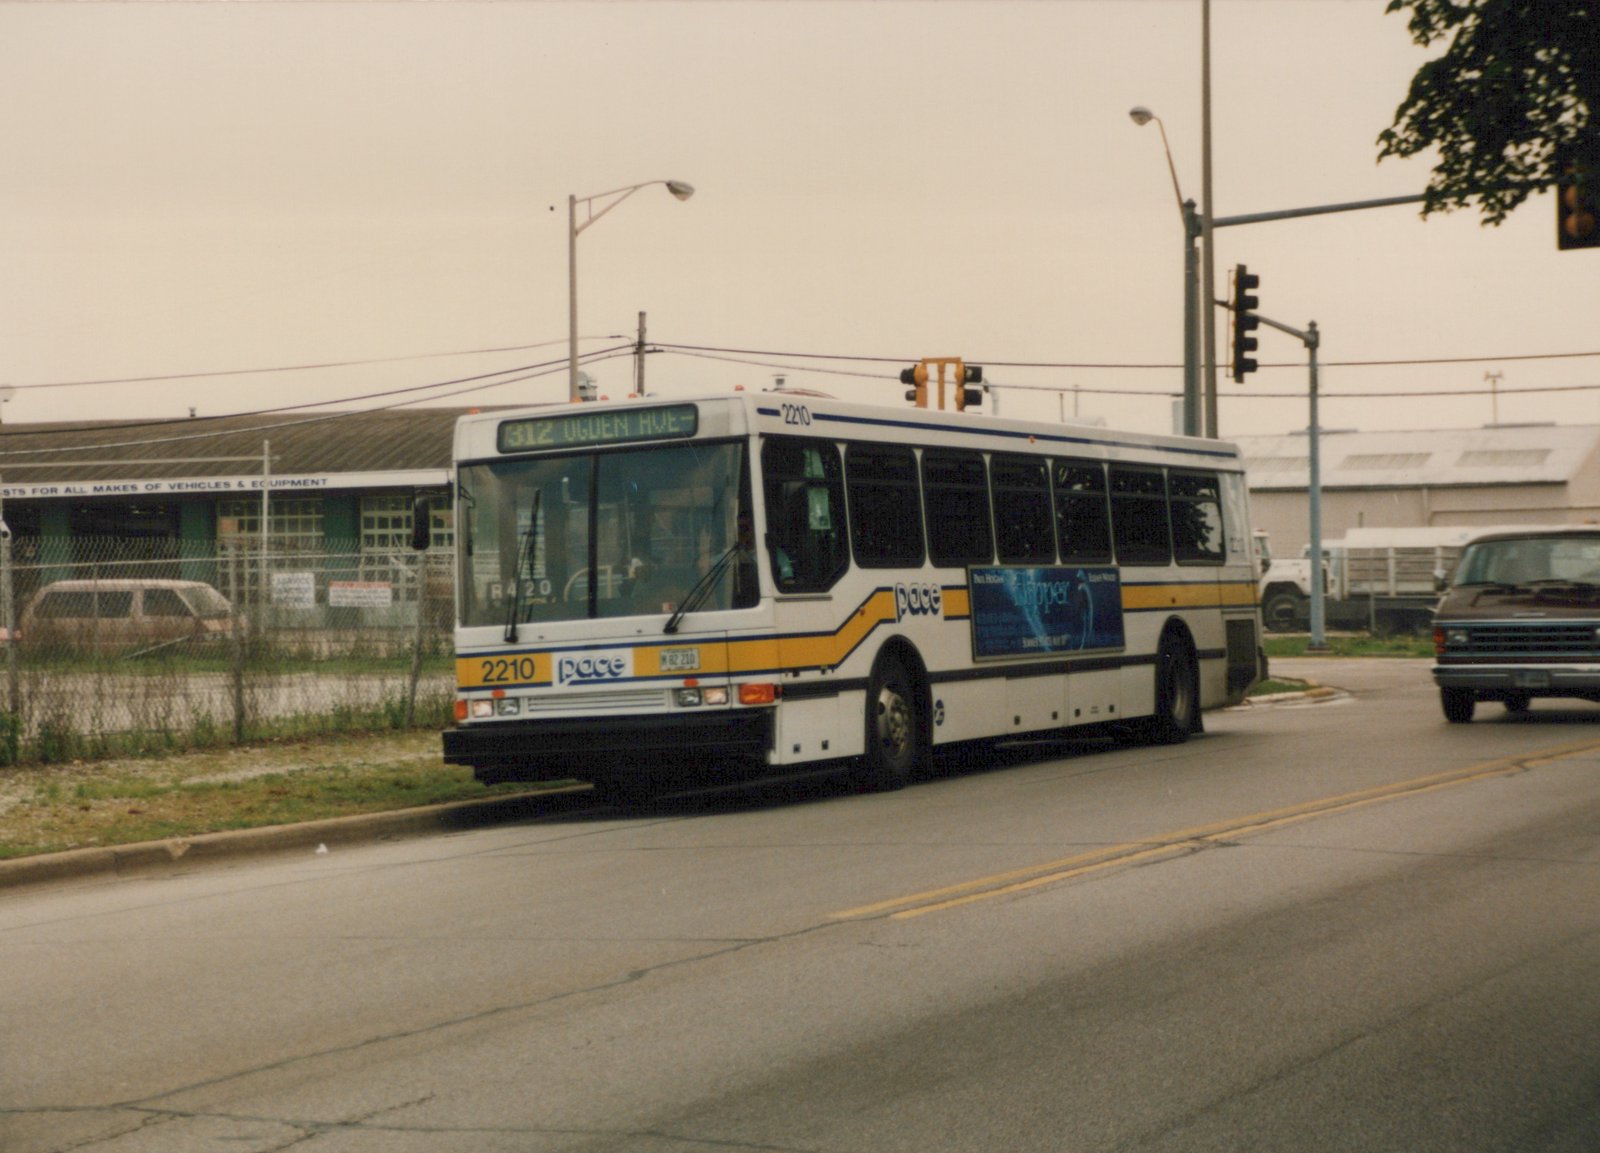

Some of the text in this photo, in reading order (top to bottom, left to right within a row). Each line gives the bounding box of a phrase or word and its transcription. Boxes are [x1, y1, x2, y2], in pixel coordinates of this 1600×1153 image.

[781, 403, 811, 427] 2210
[508, 420, 555, 446] 312
[564, 414, 630, 441] OGDEN
[0, 487, 26, 496] STS
[32, 487, 58, 495] FOR
[64, 486, 88, 494] ALL
[93, 484, 138, 493] MAKES
[144, 483, 162, 491] OF
[168, 481, 231, 490] VEHICLES
[237, 480, 245, 488] &
[895, 582, 942, 623] pace
[481, 657, 535, 683] 2210
[558, 655, 626, 684] pace
